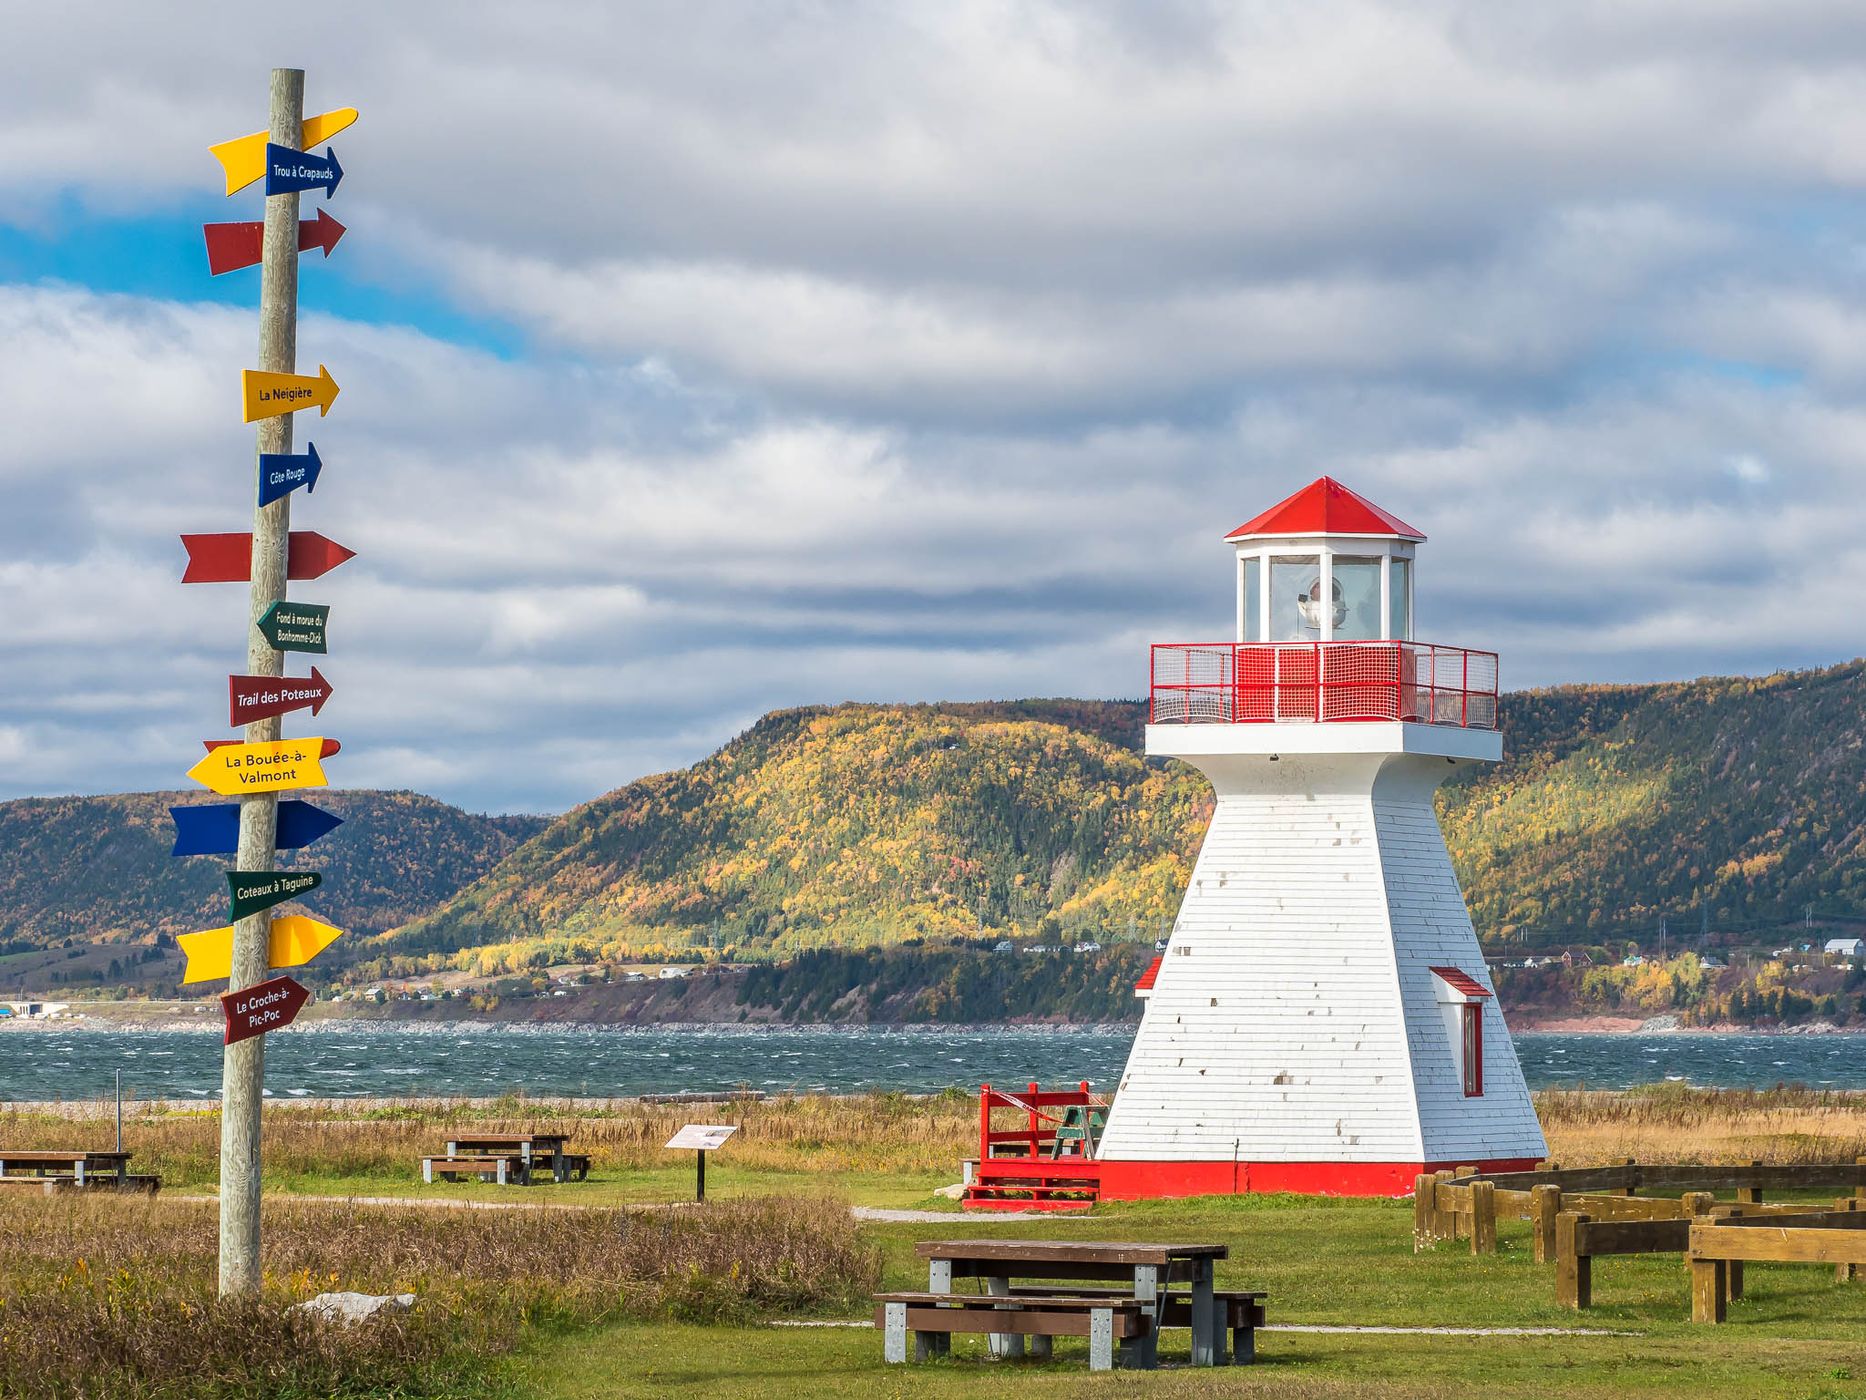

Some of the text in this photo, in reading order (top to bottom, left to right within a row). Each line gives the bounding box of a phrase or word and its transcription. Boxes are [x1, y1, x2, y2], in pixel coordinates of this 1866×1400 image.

[273, 164, 334, 181] Trou à Crapauds
[259, 386, 312, 402] La Neigière
[270, 467, 305, 485] Côte Rouge
[276, 611, 291, 624] Fond
[296, 615, 314, 626] morue
[315, 613, 322, 627] du
[237, 688, 322, 707] Trail des Poteaux
[226, 750, 307, 768] La Bouée-à-
[239, 769, 297, 784] Valmont
[237, 875, 314, 900] Coteaux à Taguine
[236, 987, 290, 1015] Le Croche-à-
[249, 1010, 280, 1028] Pic-Poc
